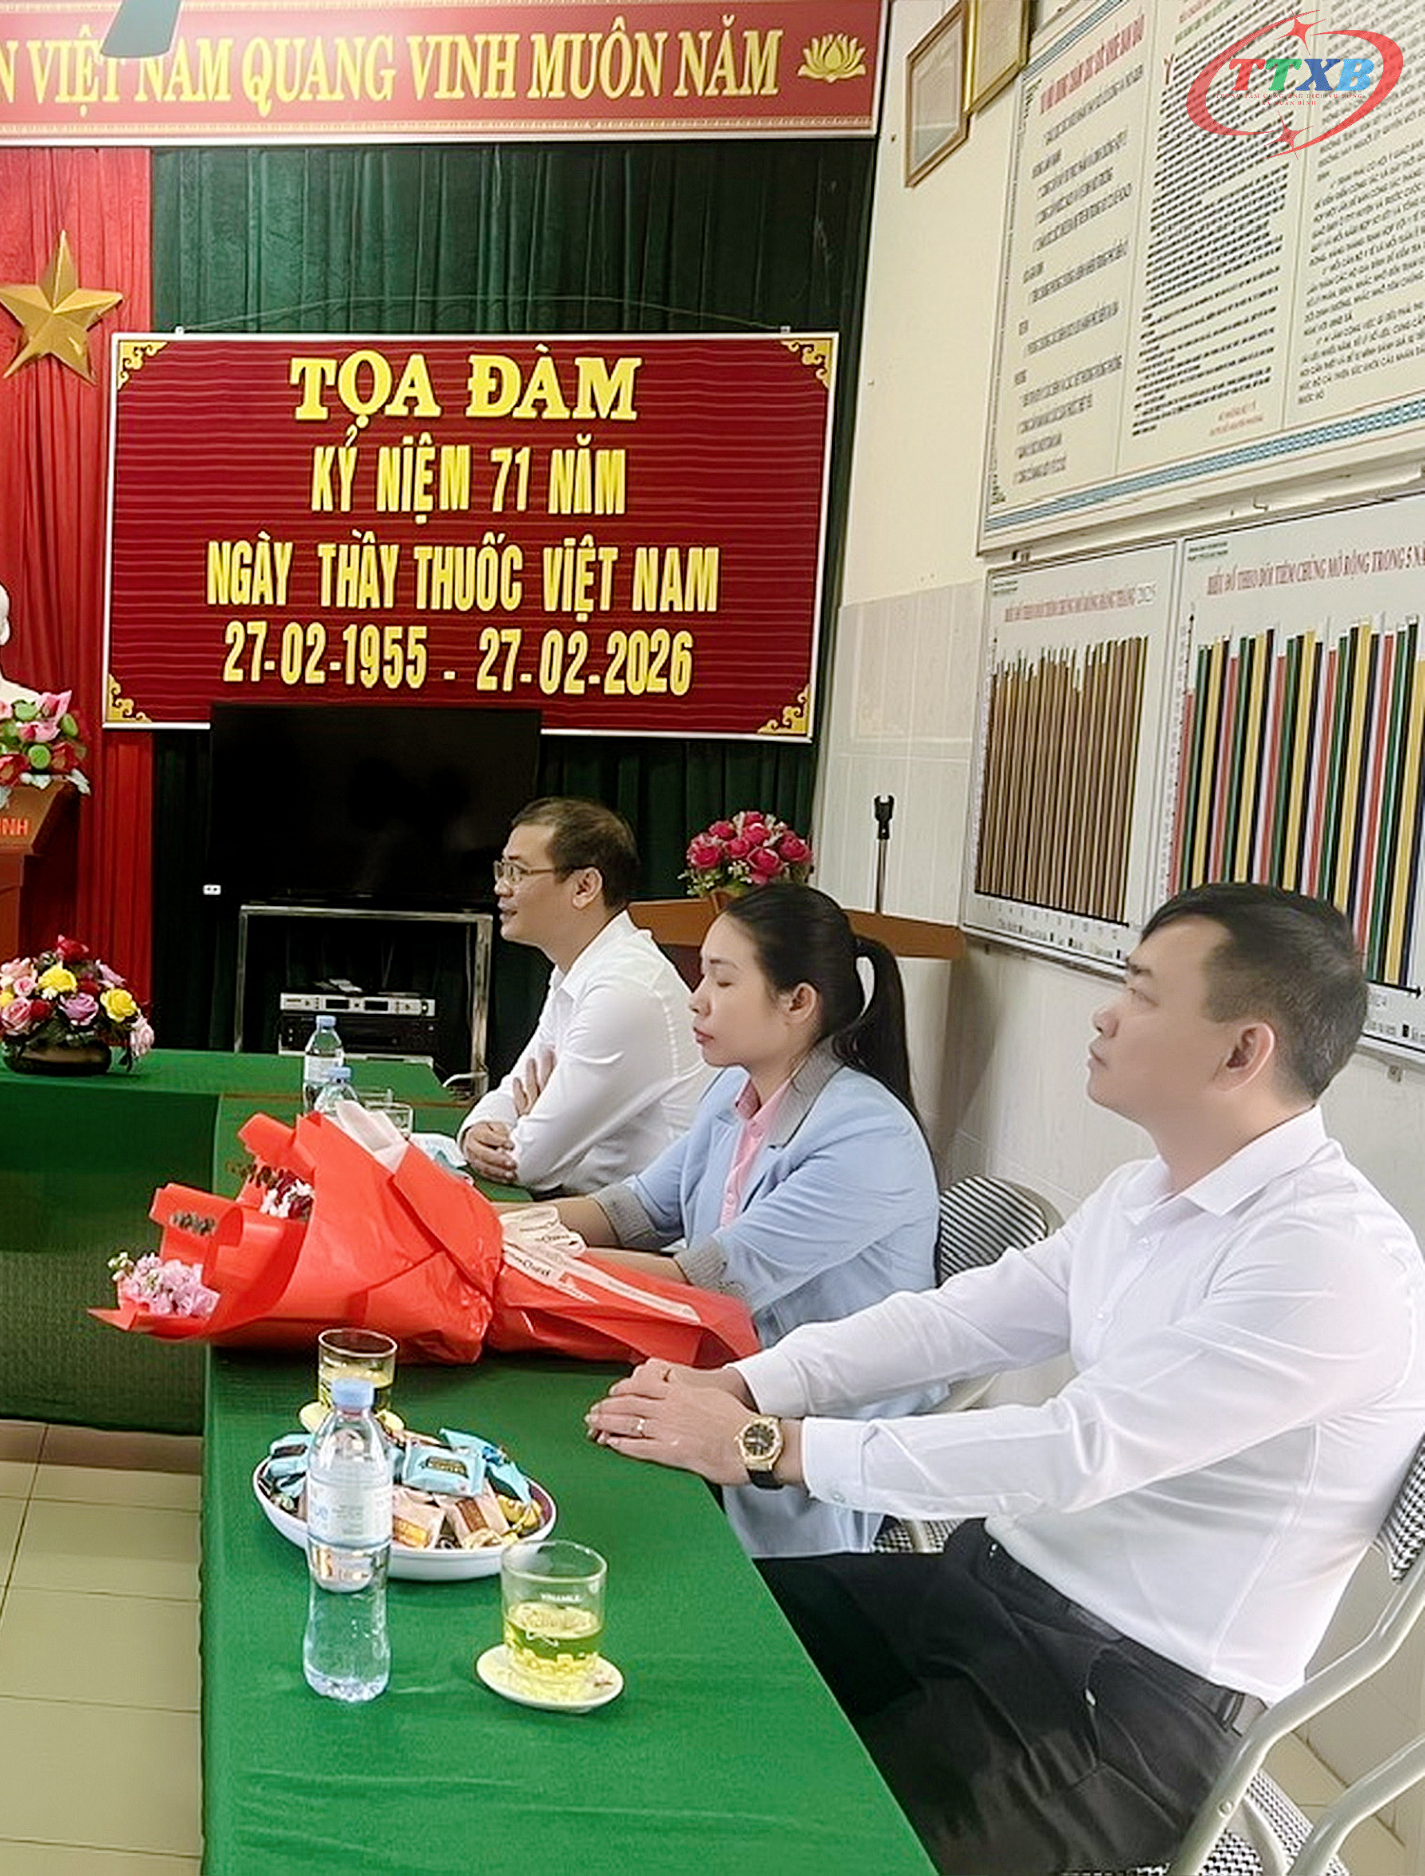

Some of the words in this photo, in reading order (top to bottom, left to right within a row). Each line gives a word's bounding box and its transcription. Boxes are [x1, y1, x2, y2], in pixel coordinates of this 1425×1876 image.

[29, 25, 126, 117] VIỆT
[135, 37, 234, 102] NAM
[241, 36, 397, 117] QUANG
[407, 33, 520, 100] VINH
[527, 16, 668, 100] MUÔN
[674, 15, 783, 97] NĂM
[289, 349, 442, 429] TỌA
[465, 342, 643, 421] ĐÀM
[311, 425, 358, 512] KỶ
[376, 432, 471, 525] NIỆM
[490, 446, 531, 513] 71
[547, 433, 626, 515] NĂM
[207, 530, 294, 606] NGÀY
[317, 529, 401, 609] THẦY
[413, 531, 524, 612] THUỐC
[543, 533, 619, 623] VIỆT
[631, 546, 720, 613] NAM
[222, 620, 429, 689] 27-02-1955
[476, 626, 694, 696] 27-02-2026
